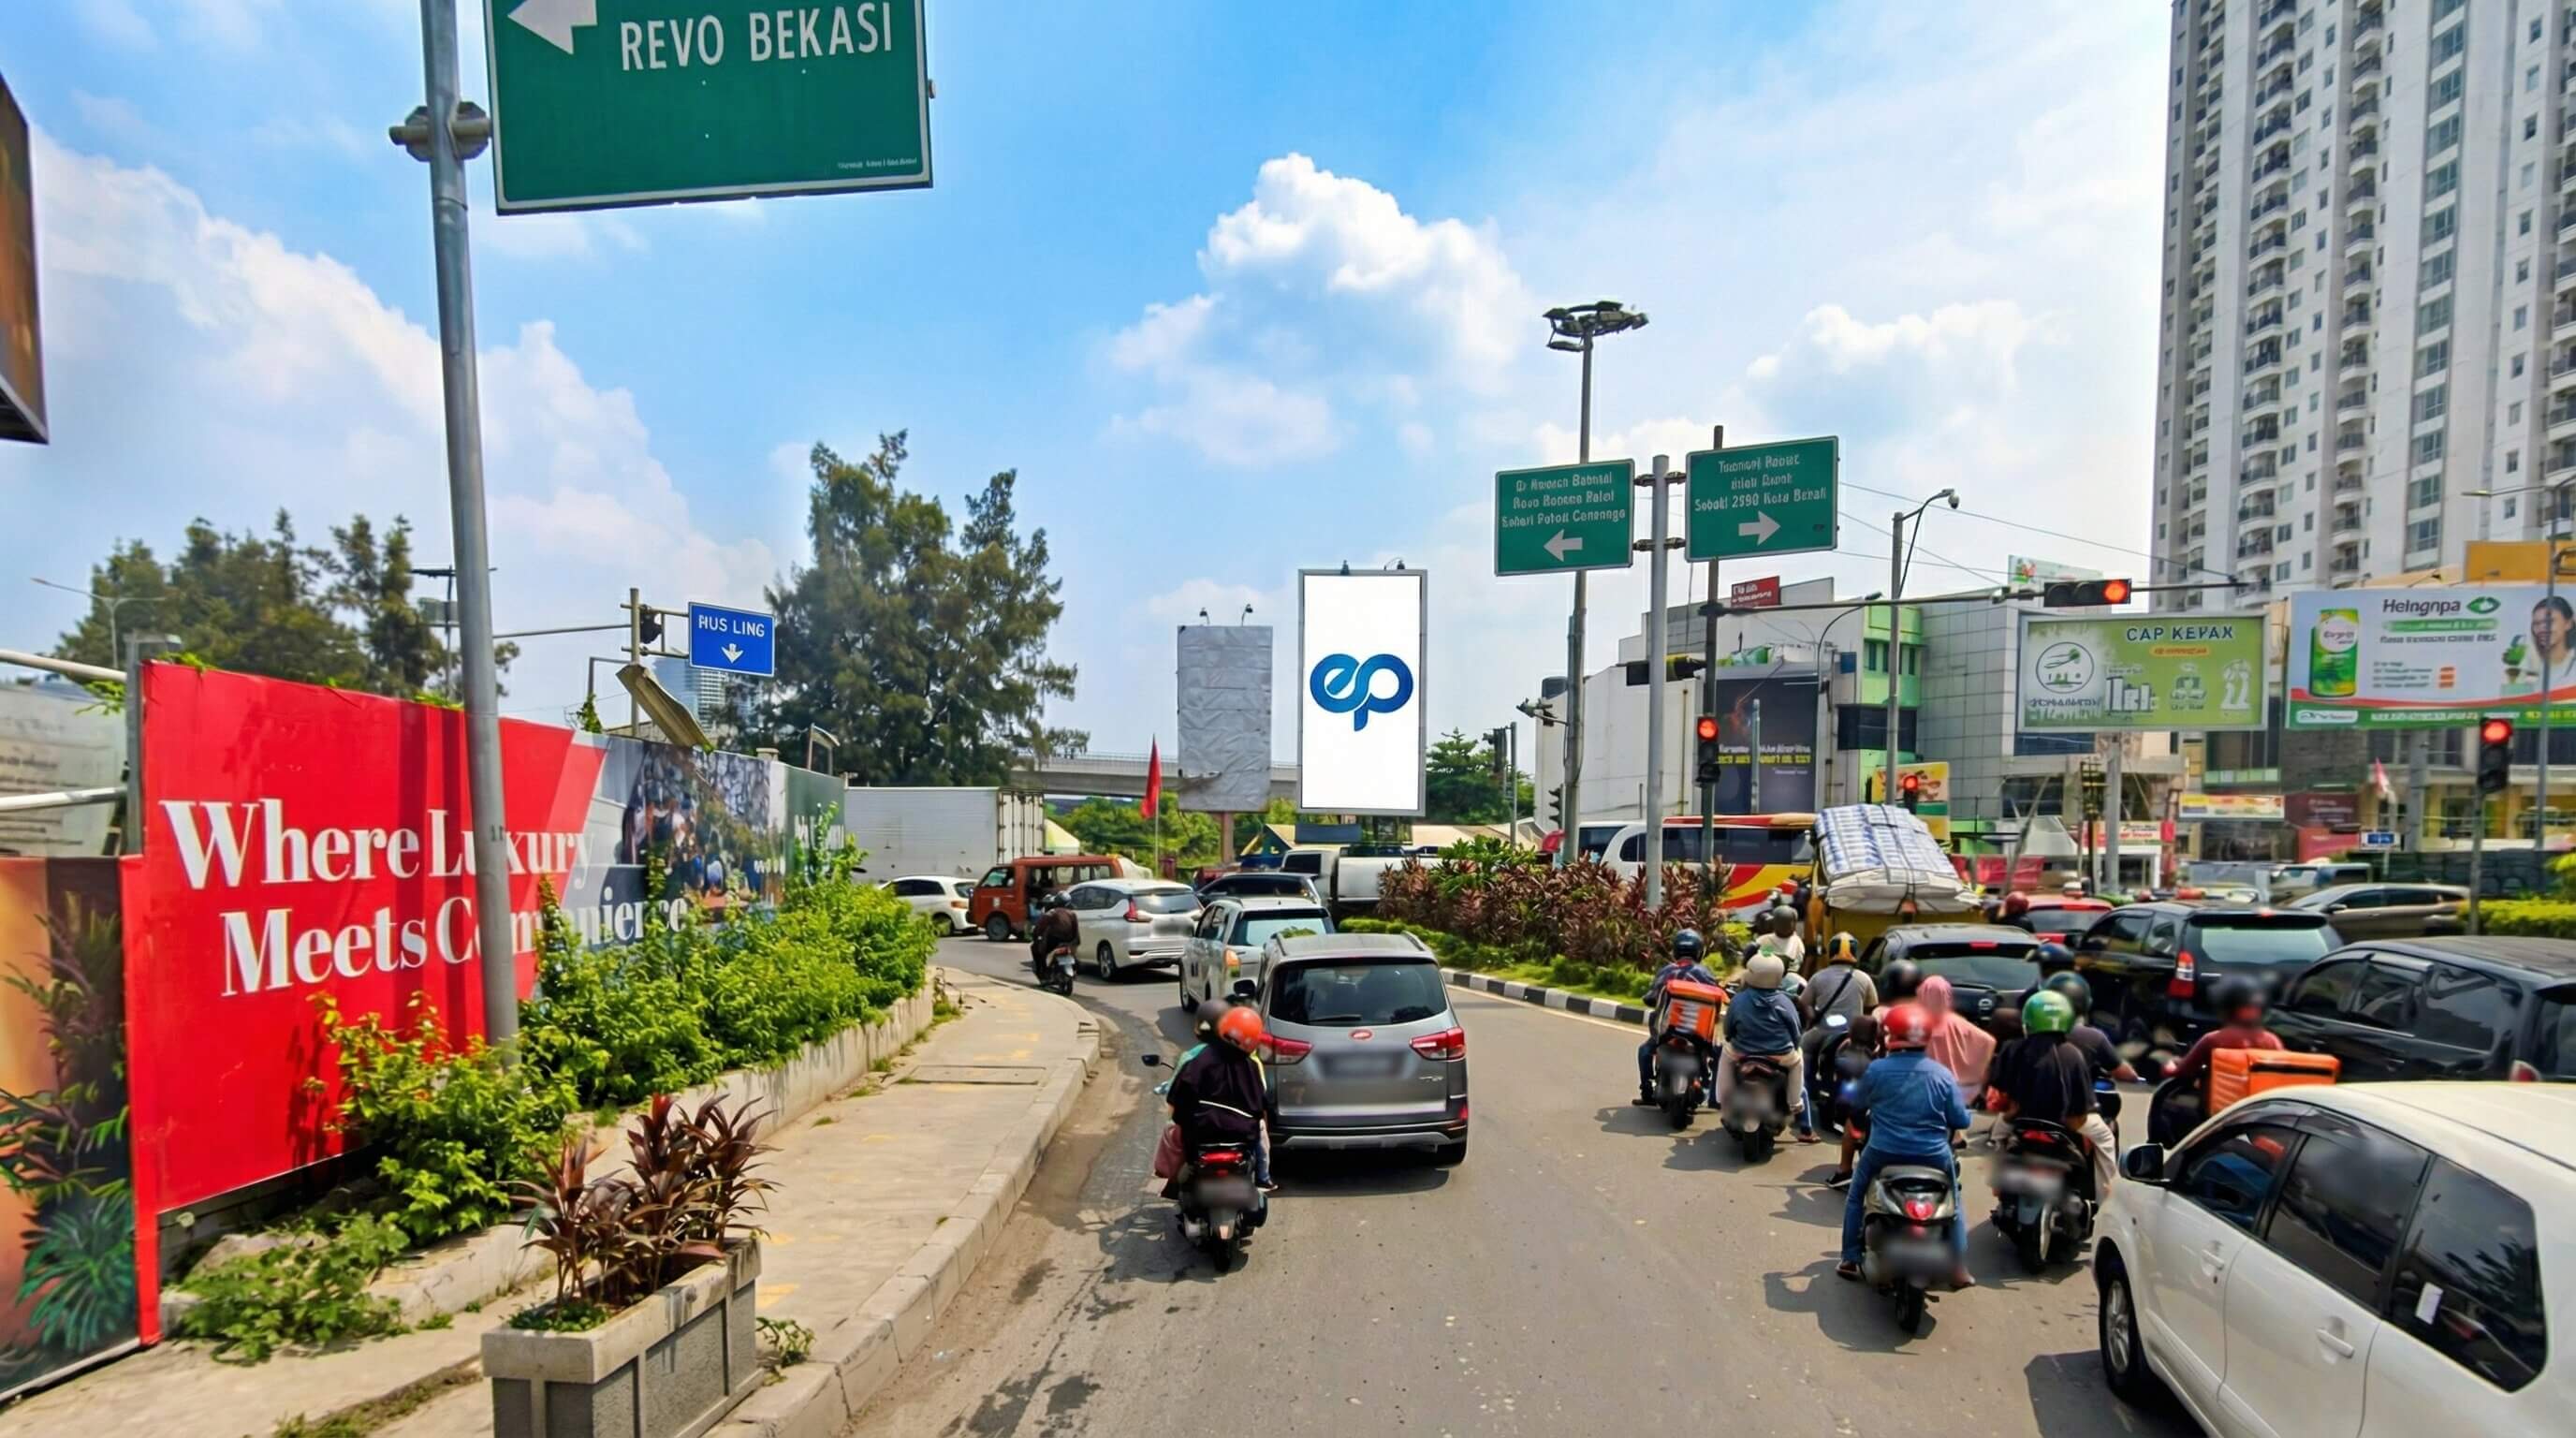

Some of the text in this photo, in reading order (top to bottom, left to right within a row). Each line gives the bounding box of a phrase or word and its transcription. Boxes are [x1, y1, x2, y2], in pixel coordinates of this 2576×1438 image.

[621, 2, 892, 70] REVO BEKASI
[733, 619, 765, 638] LING
[2127, 626, 2164, 641] CAP
[158, 798, 421, 890] Where
[219, 905, 429, 997] Meets
